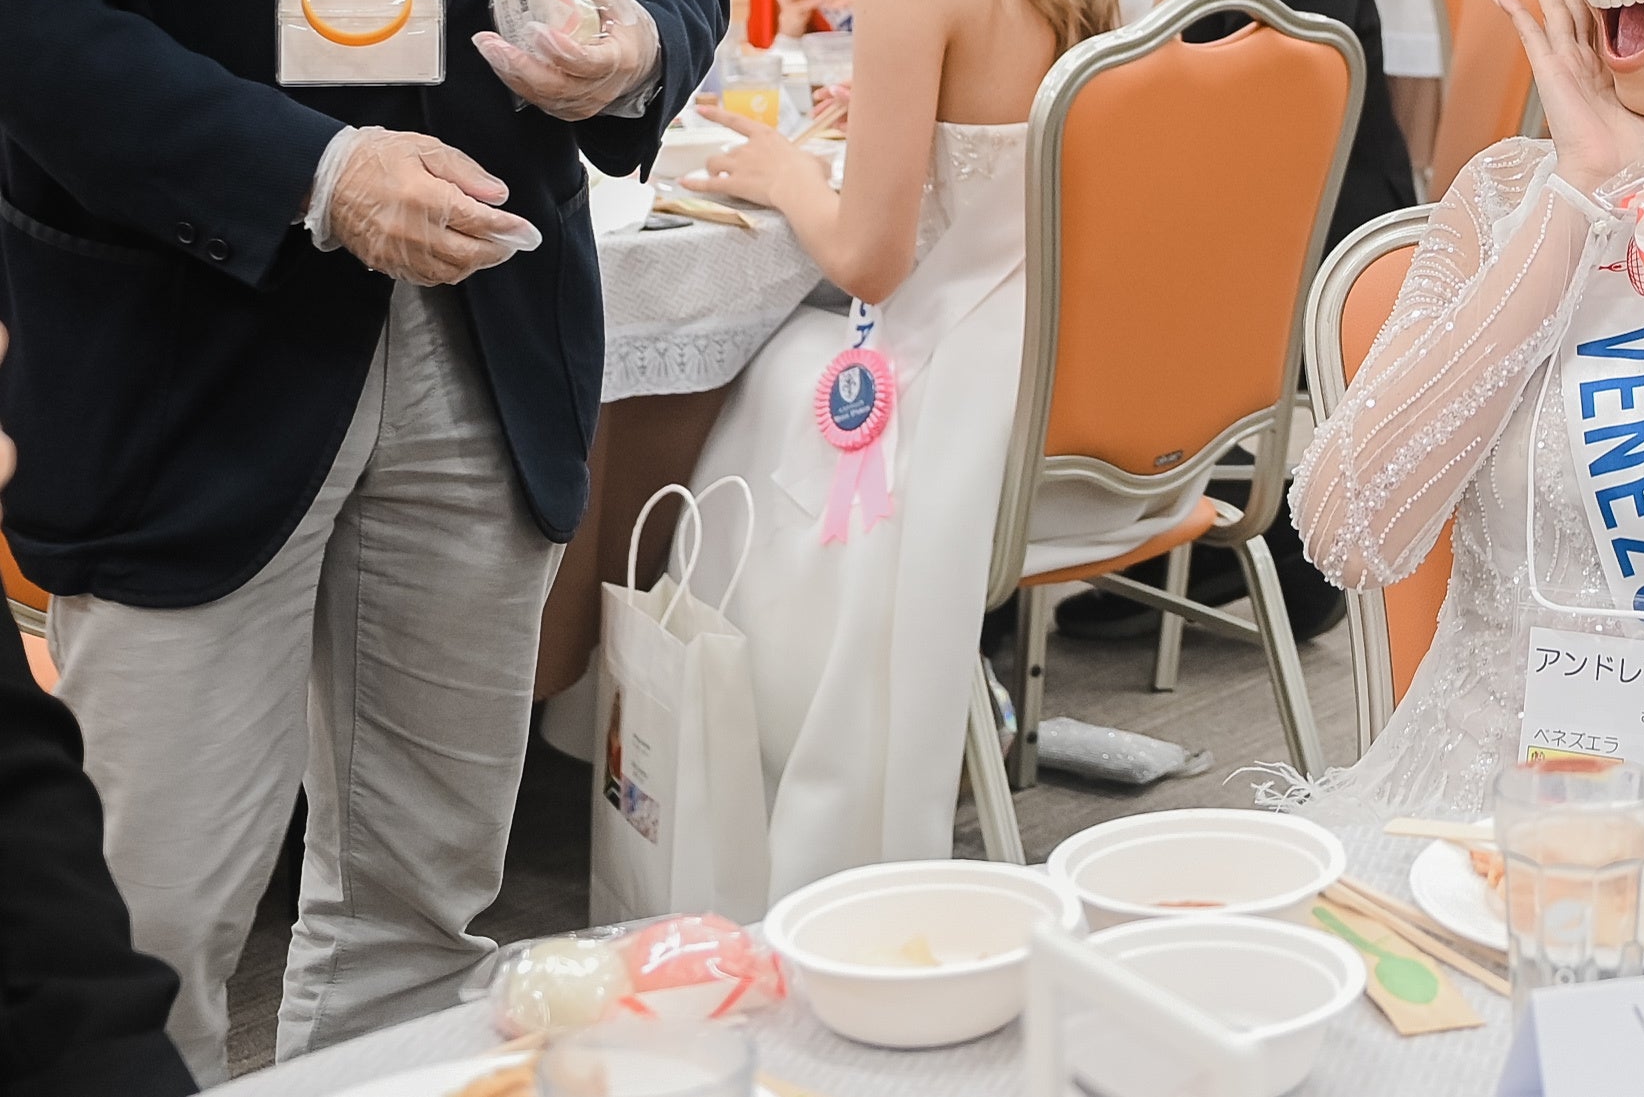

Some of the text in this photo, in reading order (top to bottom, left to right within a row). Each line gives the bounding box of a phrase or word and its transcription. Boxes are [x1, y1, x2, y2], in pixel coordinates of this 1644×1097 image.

[1533, 728, 1620, 754] ベネズエラ
